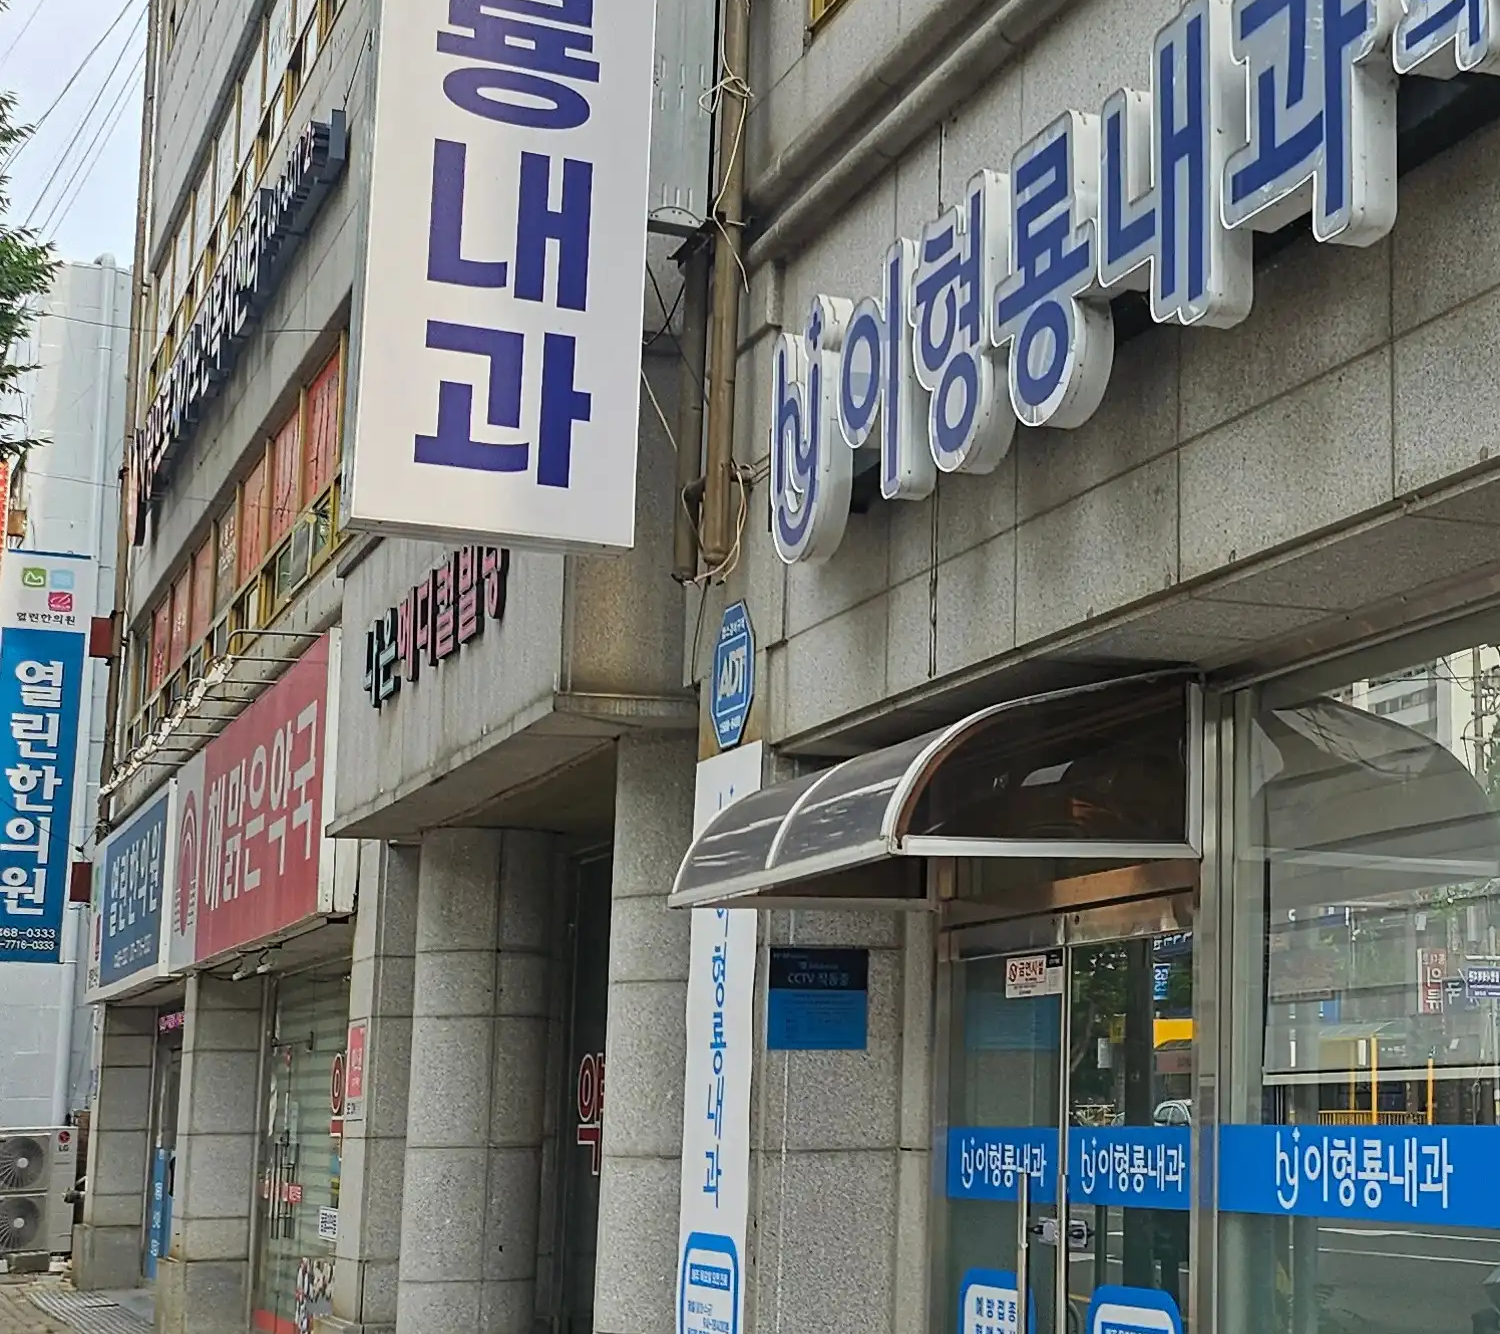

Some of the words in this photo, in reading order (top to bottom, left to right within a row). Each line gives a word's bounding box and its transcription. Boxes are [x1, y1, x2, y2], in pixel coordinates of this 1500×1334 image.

[720, 647, 746, 697] ADT
[0, 659, 63, 916] 열린한의원
[203, 698, 317, 911] 해맑은약국
[787, 972, 815, 984] CCTV
[975, 1142, 1047, 1188] 이형룡내과
[1098, 1143, 1185, 1192] 이형룡내과
[1304, 1136, 1453, 1209] 이형룡내과
